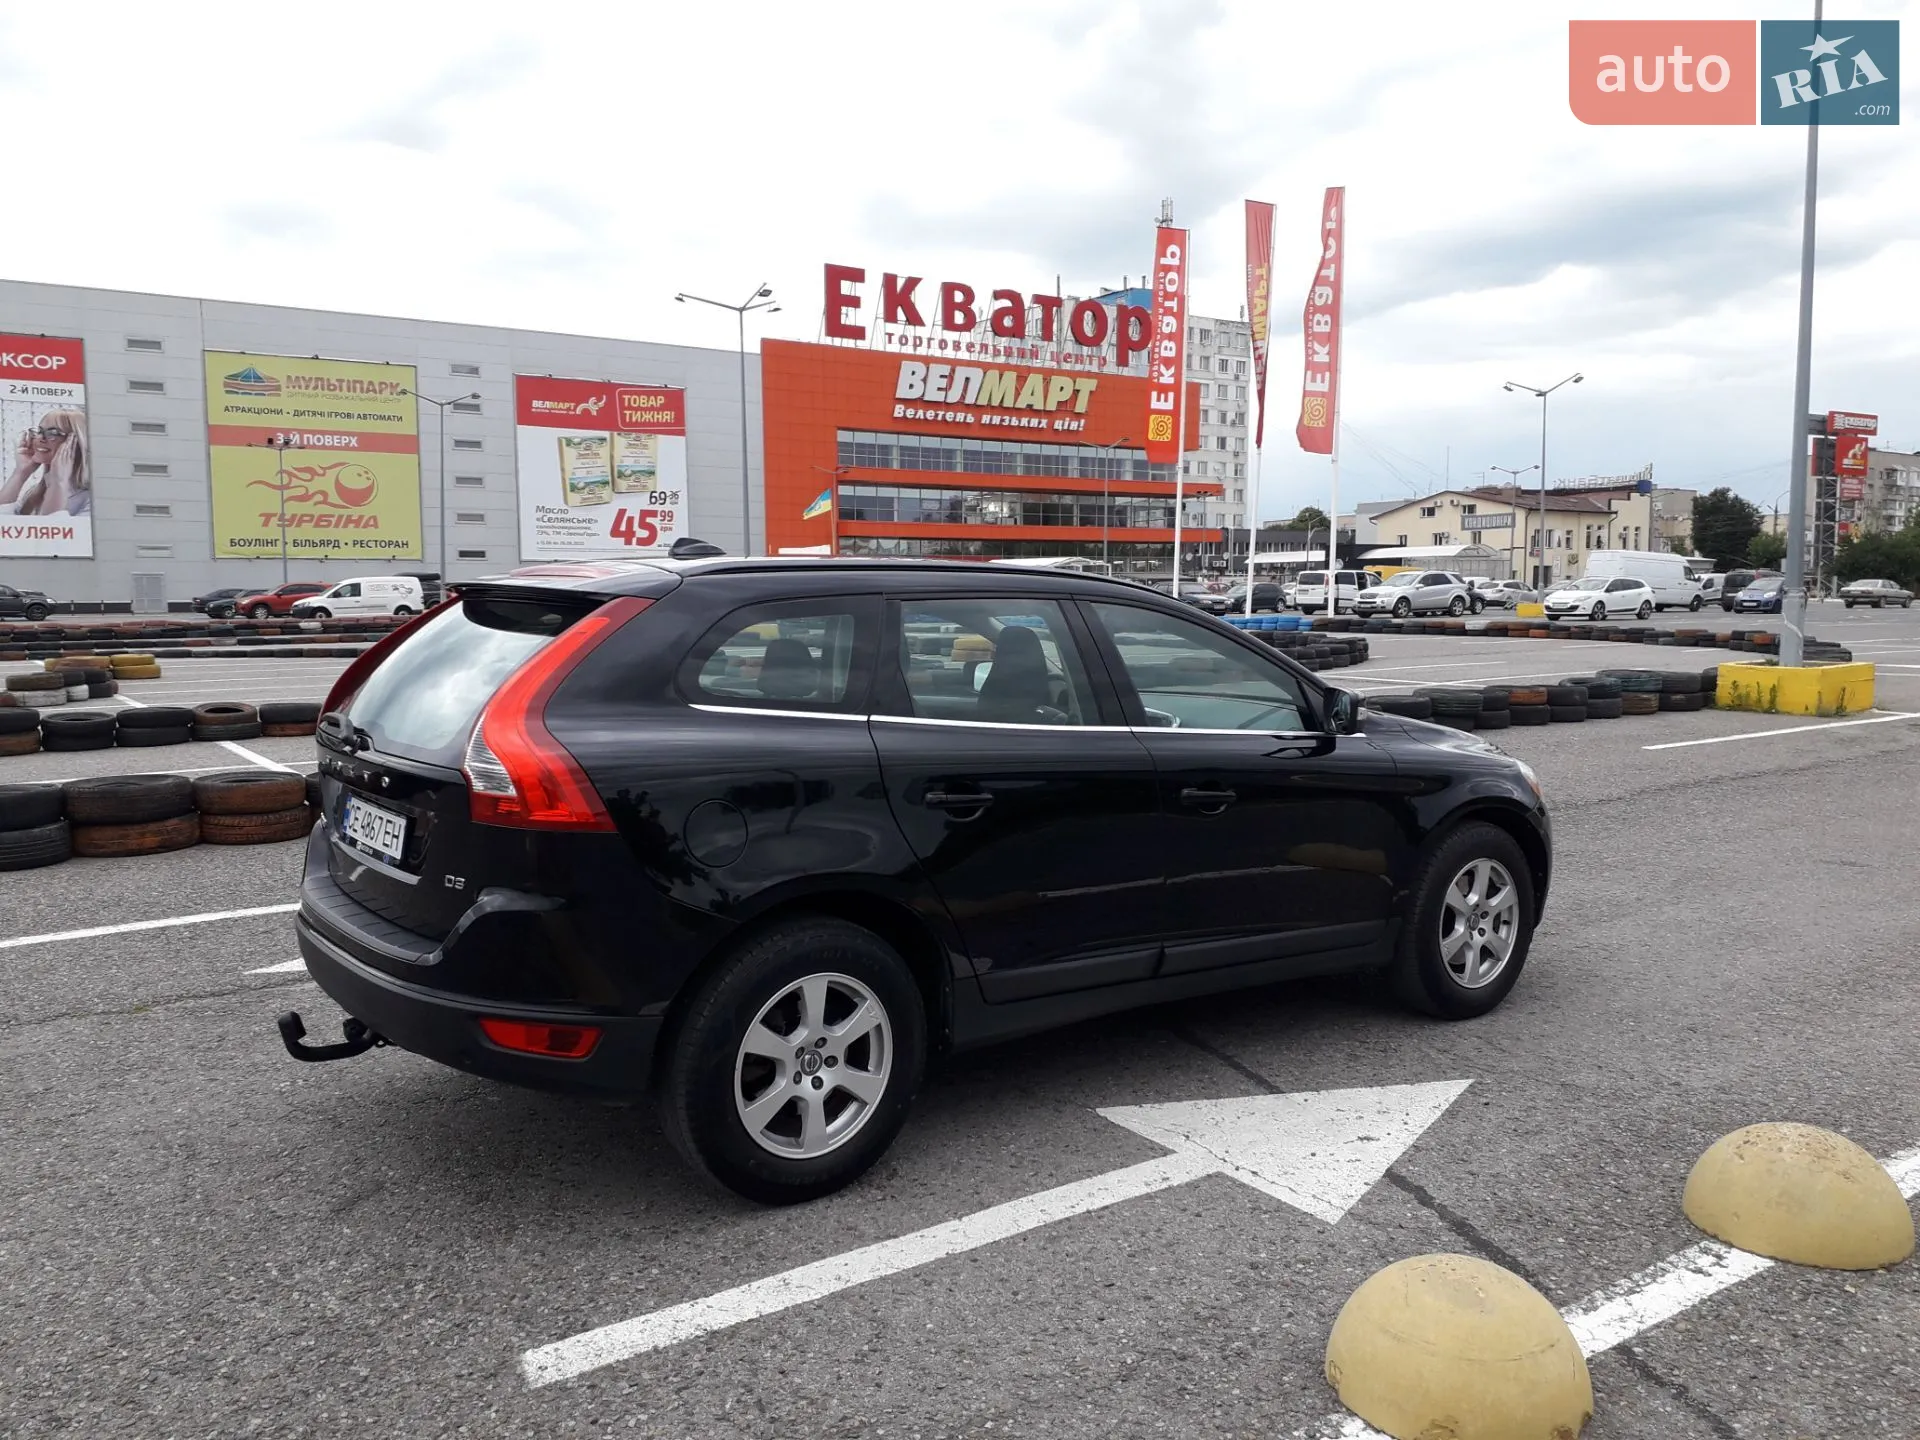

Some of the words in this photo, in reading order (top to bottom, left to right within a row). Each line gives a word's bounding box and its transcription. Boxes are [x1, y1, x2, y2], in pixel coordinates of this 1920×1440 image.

[885, 331, 1041, 361] торговельний
[1051, 350, 1108, 368] центр
[0, 352, 67, 370] КСОР
[9, 384, 29, 395] 2-Й
[32, 387, 74, 397] ПОВЕРХ
[285, 374, 401, 396] МУЛЬТІПАРК
[895, 360, 1098, 414] ВЕЛМАРТ
[623, 394, 665, 408] ТОВАР
[223, 405, 284, 416] АТРАКЦІОНИ
[292, 409, 326, 419] ДИТЯЧІ
[326, 411, 355, 421] ІГРОВІ
[356, 413, 404, 423] АВТОМАТИ
[624, 410, 675, 424] ТИЖНЯ!
[892, 404, 975, 424] Велетень
[980, 413, 1048, 429] низьких
[1053, 418, 1086, 432] цін!
[303, 434, 359, 448] ПОВЕРХ
[535, 505, 569, 515] Масло
[258, 513, 380, 529] ТУРБІНА
[610, 508, 659, 547] 45
[659, 510, 674, 523] 99
[229, 538, 280, 548] БОУЛІНГ
[292, 539, 341, 550] БІЛЬЯРД
[352, 539, 410, 549] РЕСТОРАН
[382, 818, 402, 852] EH
[445, 874, 466, 890] D3
